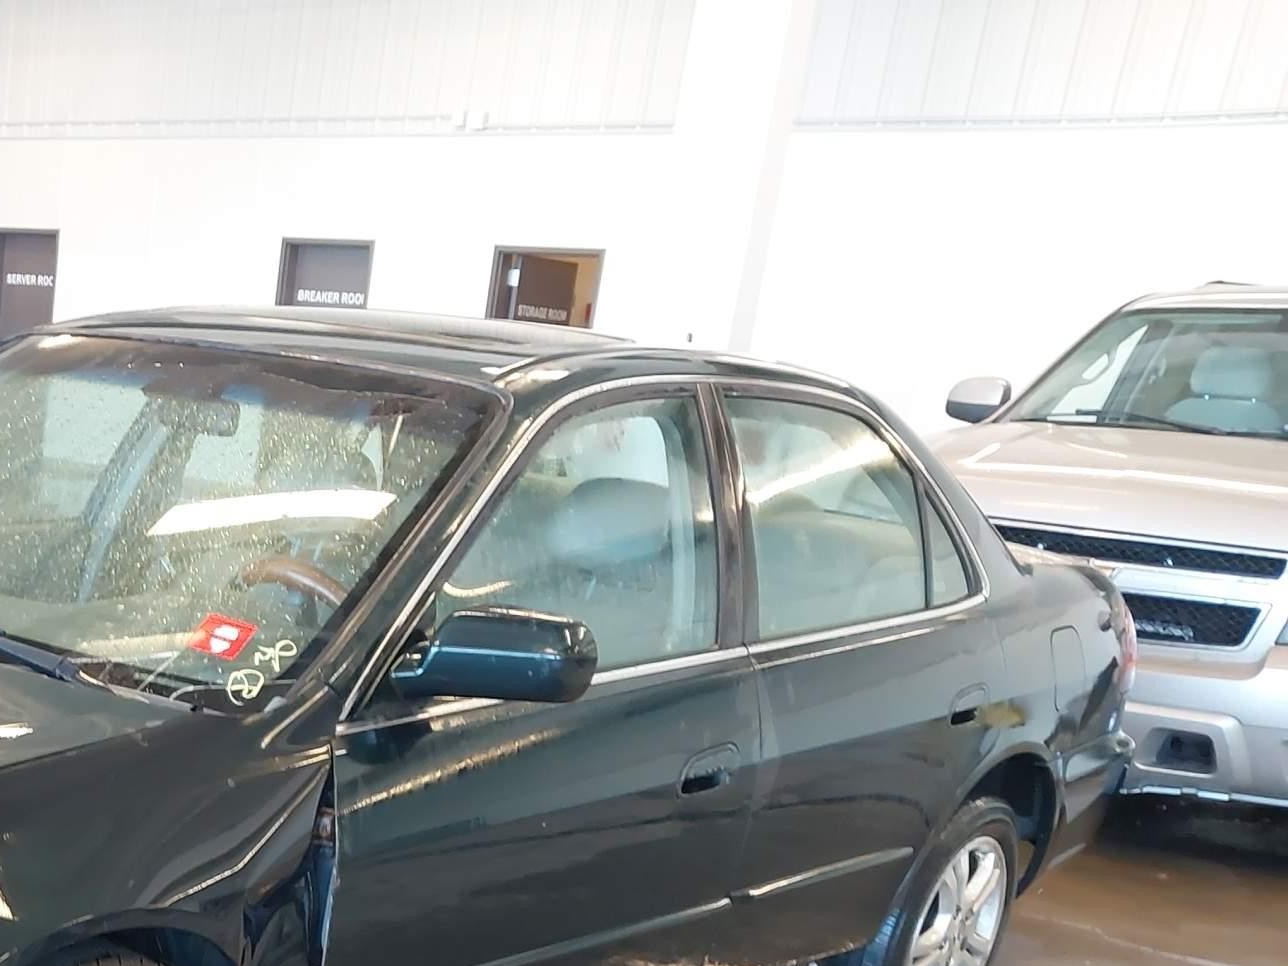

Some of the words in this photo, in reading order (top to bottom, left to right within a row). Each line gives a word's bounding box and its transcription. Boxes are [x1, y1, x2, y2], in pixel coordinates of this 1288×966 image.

[297, 289, 340, 304] BREAKER
[341, 292, 365, 305] ROO
[518, 304, 548, 319] STORAGE
